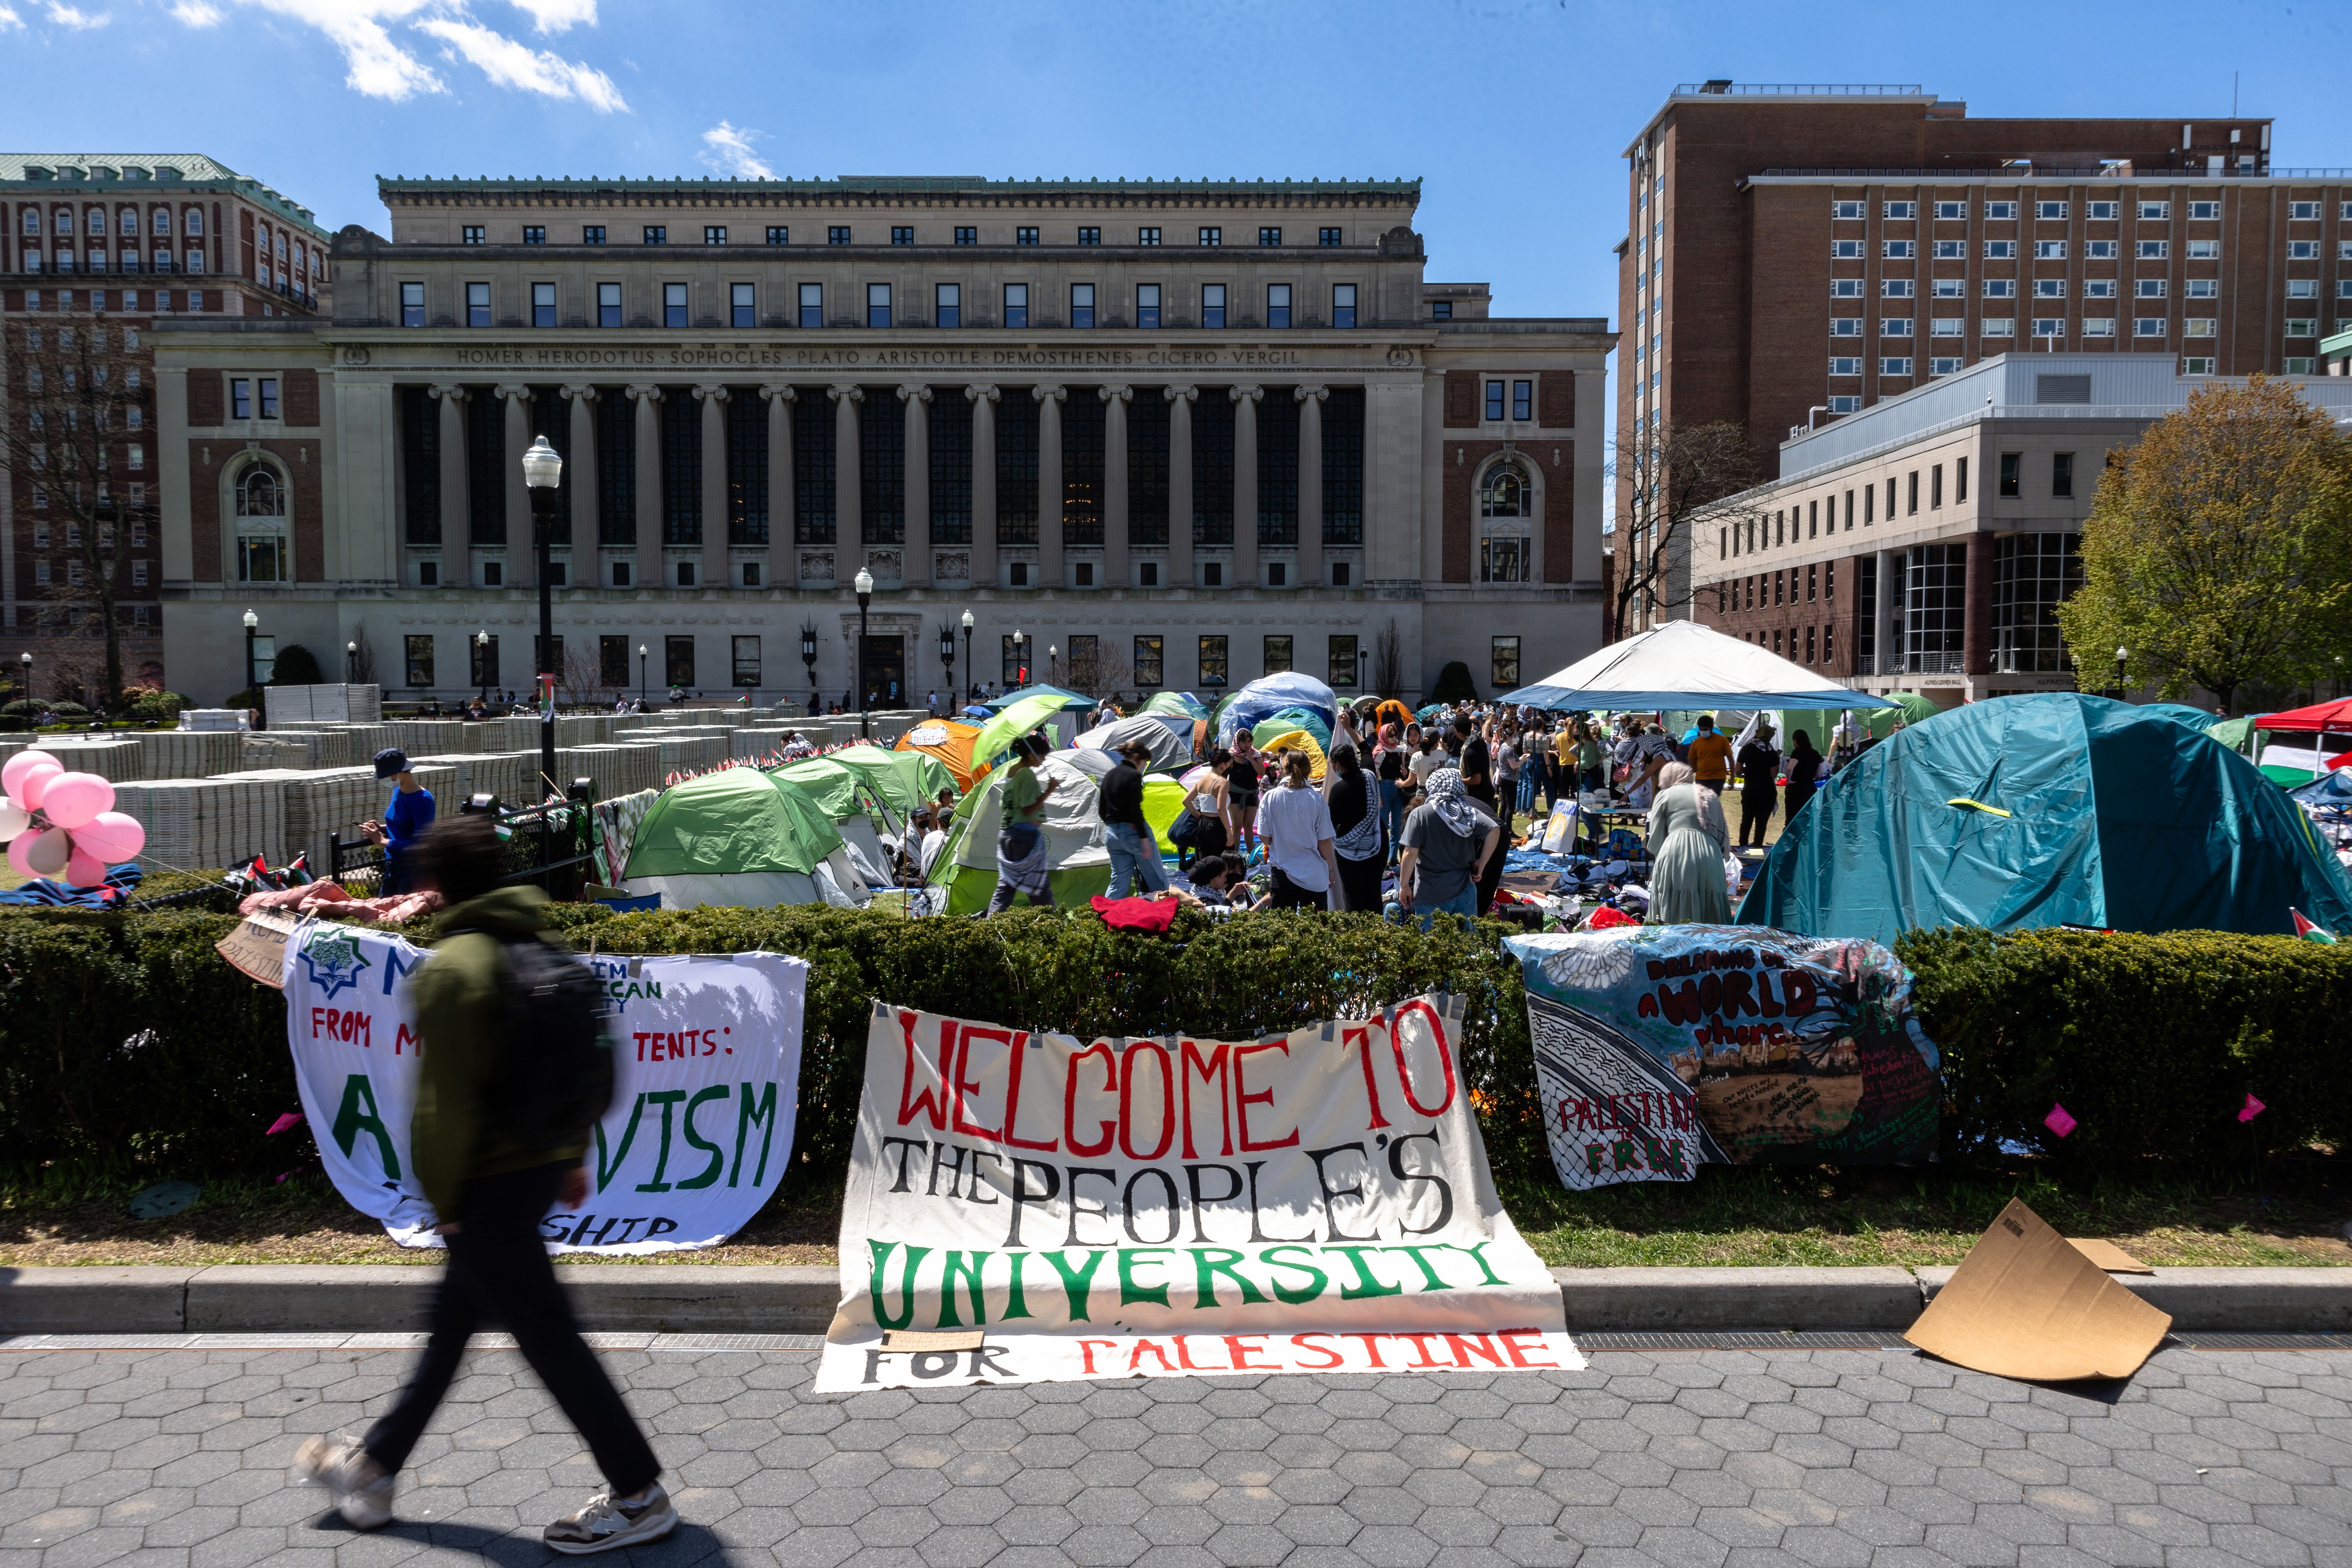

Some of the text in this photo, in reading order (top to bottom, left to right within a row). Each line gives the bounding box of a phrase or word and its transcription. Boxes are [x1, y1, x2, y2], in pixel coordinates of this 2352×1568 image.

[458, 351, 1301, 364] HOMER HERODOTUS SOPHOCLES PLATO ARISTOTLE DEMOSTHENES CICERO VERGIL
[1647, 949, 1756, 980] DREAMING
[1658, 971, 1817, 1026] WORLD
[312, 1007, 371, 1047] FROM
[633, 1027, 733, 1062] TENTS:
[898, 999, 1455, 1160] WELCOME TO
[1728, 1092, 1751, 1110] heard
[1755, 1079, 1779, 1096] needed
[1736, 1082, 1758, 1096] voices
[1585, 1137, 1688, 1175] FREE
[882, 1125, 1452, 1248] THE PEOPLE'S
[867, 1238, 1514, 1330] UNIVERSITY
[862, 1327, 1561, 1384] FOR PALESTINE
